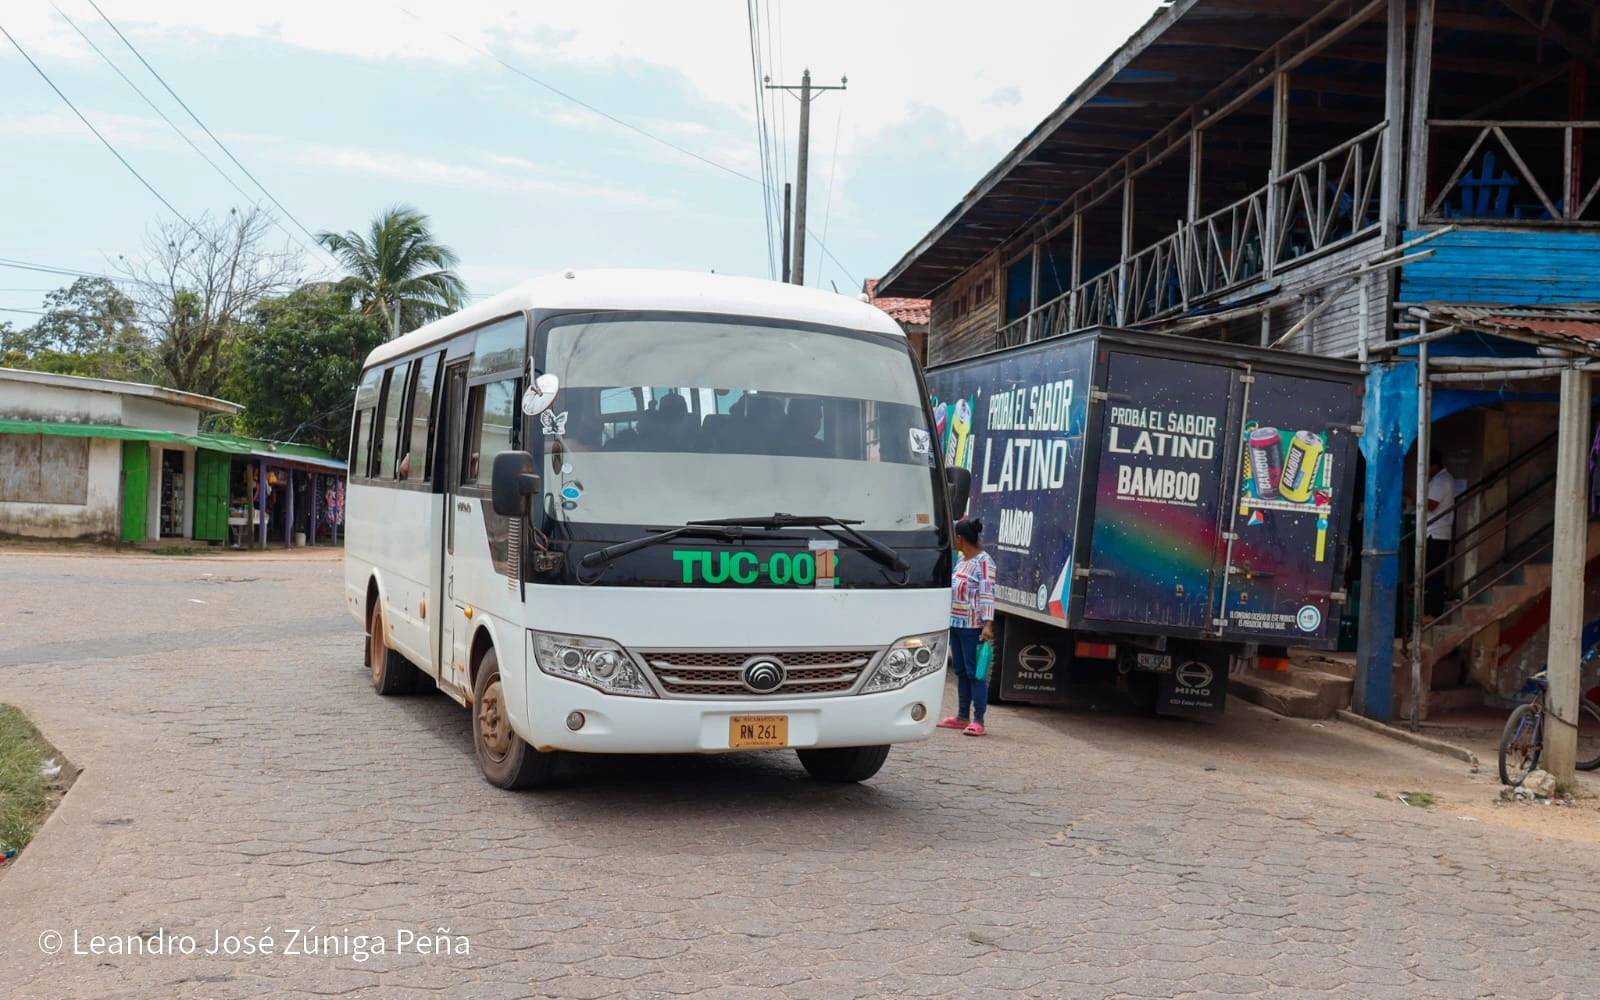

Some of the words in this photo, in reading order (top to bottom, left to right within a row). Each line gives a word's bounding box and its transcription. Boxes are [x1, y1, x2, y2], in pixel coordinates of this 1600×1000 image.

[988, 384, 1016, 430] PROBÁ
[1014, 388, 1026, 430] EL
[1028, 379, 1073, 432] SABOR
[1110, 407, 1147, 428] PROBÁ
[1149, 411, 1165, 430] EL
[1167, 412, 1216, 438] SABOR
[1109, 426, 1214, 459] LATINO
[981, 437, 1068, 493] LATINO
[1283, 448, 1302, 487] BAMBOO
[1117, 465, 1200, 501] BAMBOO
[998, 508, 1034, 547] BAMBOO
[1017, 671, 1054, 680] HINO
[1175, 686, 1210, 696] HINO
[740, 725, 754, 739] RN
[757, 725, 777, 739] 261
